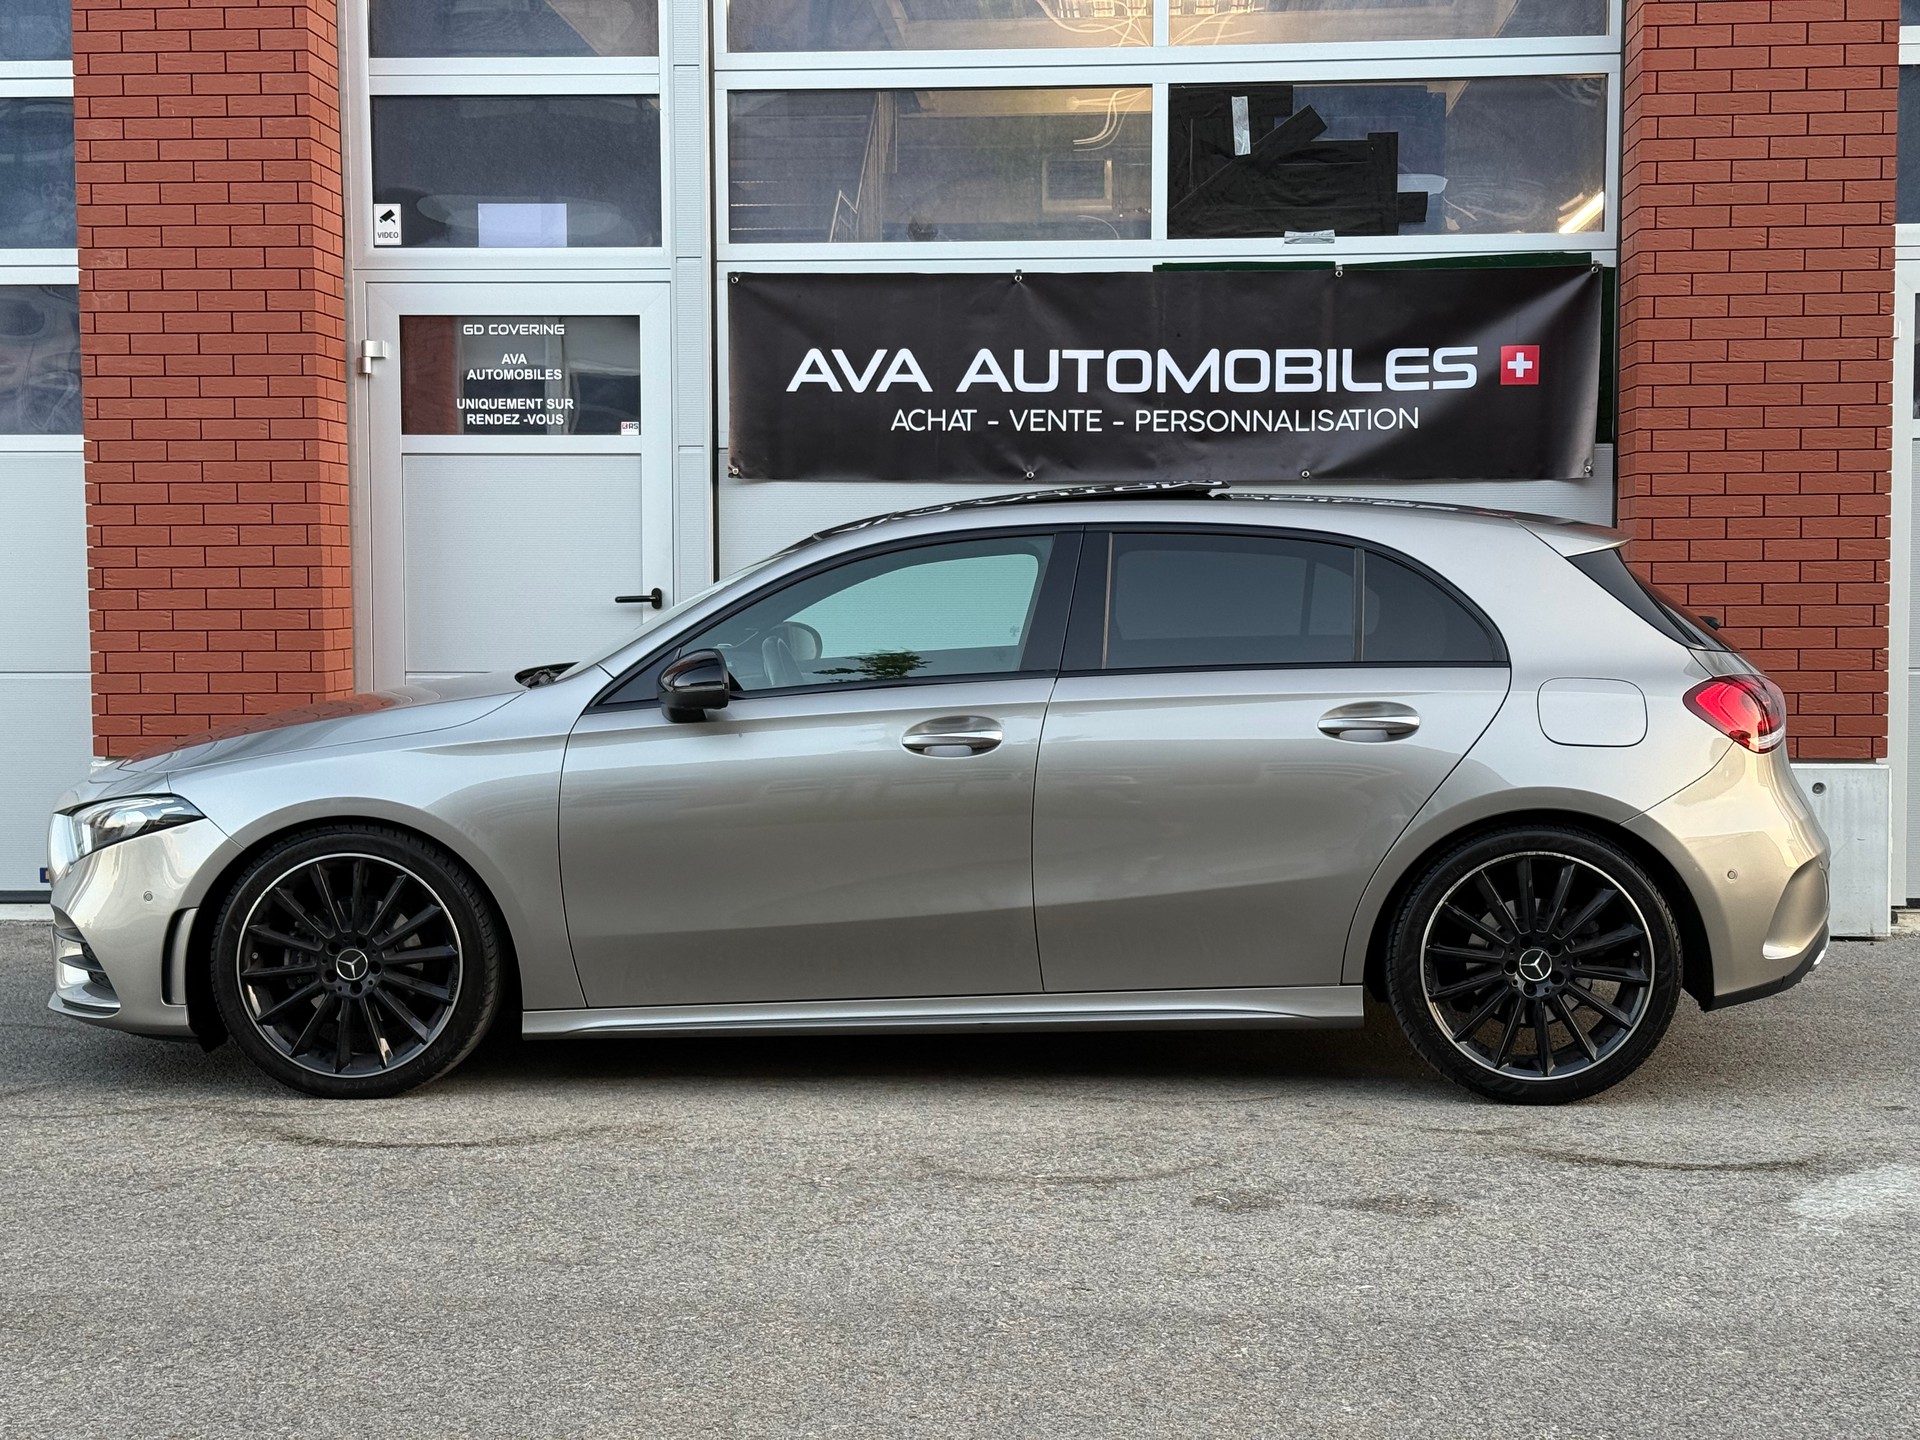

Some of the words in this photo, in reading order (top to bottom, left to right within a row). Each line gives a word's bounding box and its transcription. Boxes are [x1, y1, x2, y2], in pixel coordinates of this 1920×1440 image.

[377, 231, 399, 239] VIDEO
[463, 324, 485, 335] GD
[488, 324, 565, 335] COVERING
[501, 353, 528, 365] AVA
[466, 368, 563, 381] AUTOMOBILES
[786, 347, 934, 393] AVA
[956, 346, 1479, 394] AUTOMOBILES
[456, 398, 544, 410] UNIQUEMENT
[546, 398, 574, 410] SUR
[466, 413, 520, 425] RENDEZ
[890, 408, 978, 432] ACHAT
[1009, 409, 1103, 433] VENTE
[1135, 406, 1420, 433] PERSONNALISATION
